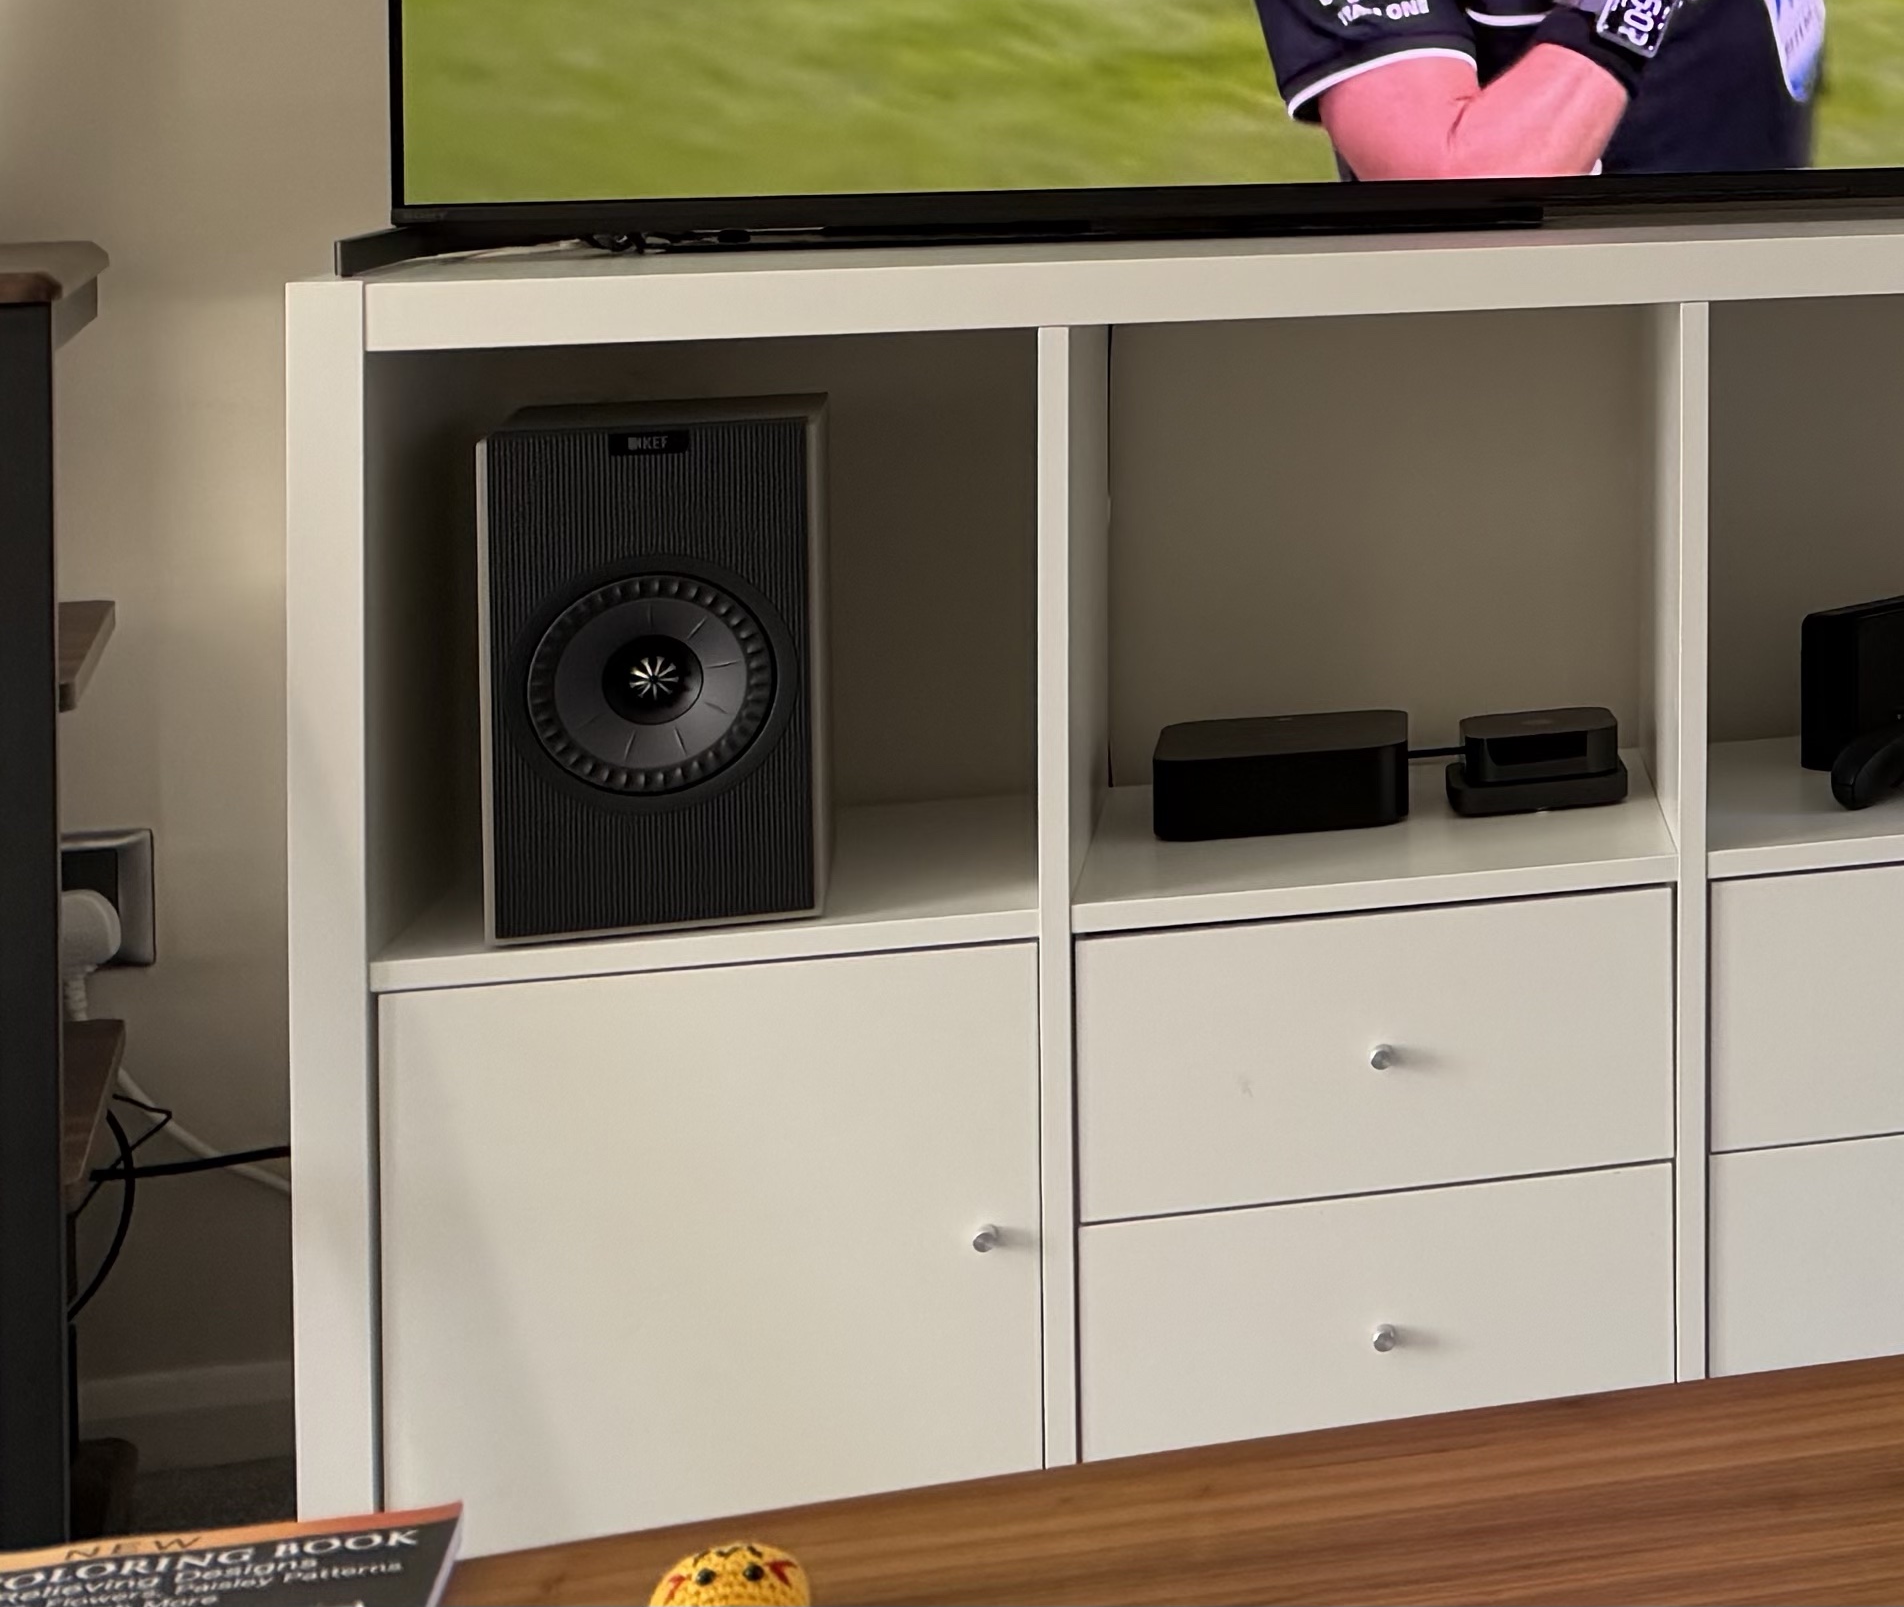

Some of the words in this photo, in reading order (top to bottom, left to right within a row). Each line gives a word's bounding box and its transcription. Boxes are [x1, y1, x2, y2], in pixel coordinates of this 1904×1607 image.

[0, 1547, 256, 1591] OLORING
[273, 1529, 419, 1558] BOOK
[174, 1558, 318, 1585] Designs
